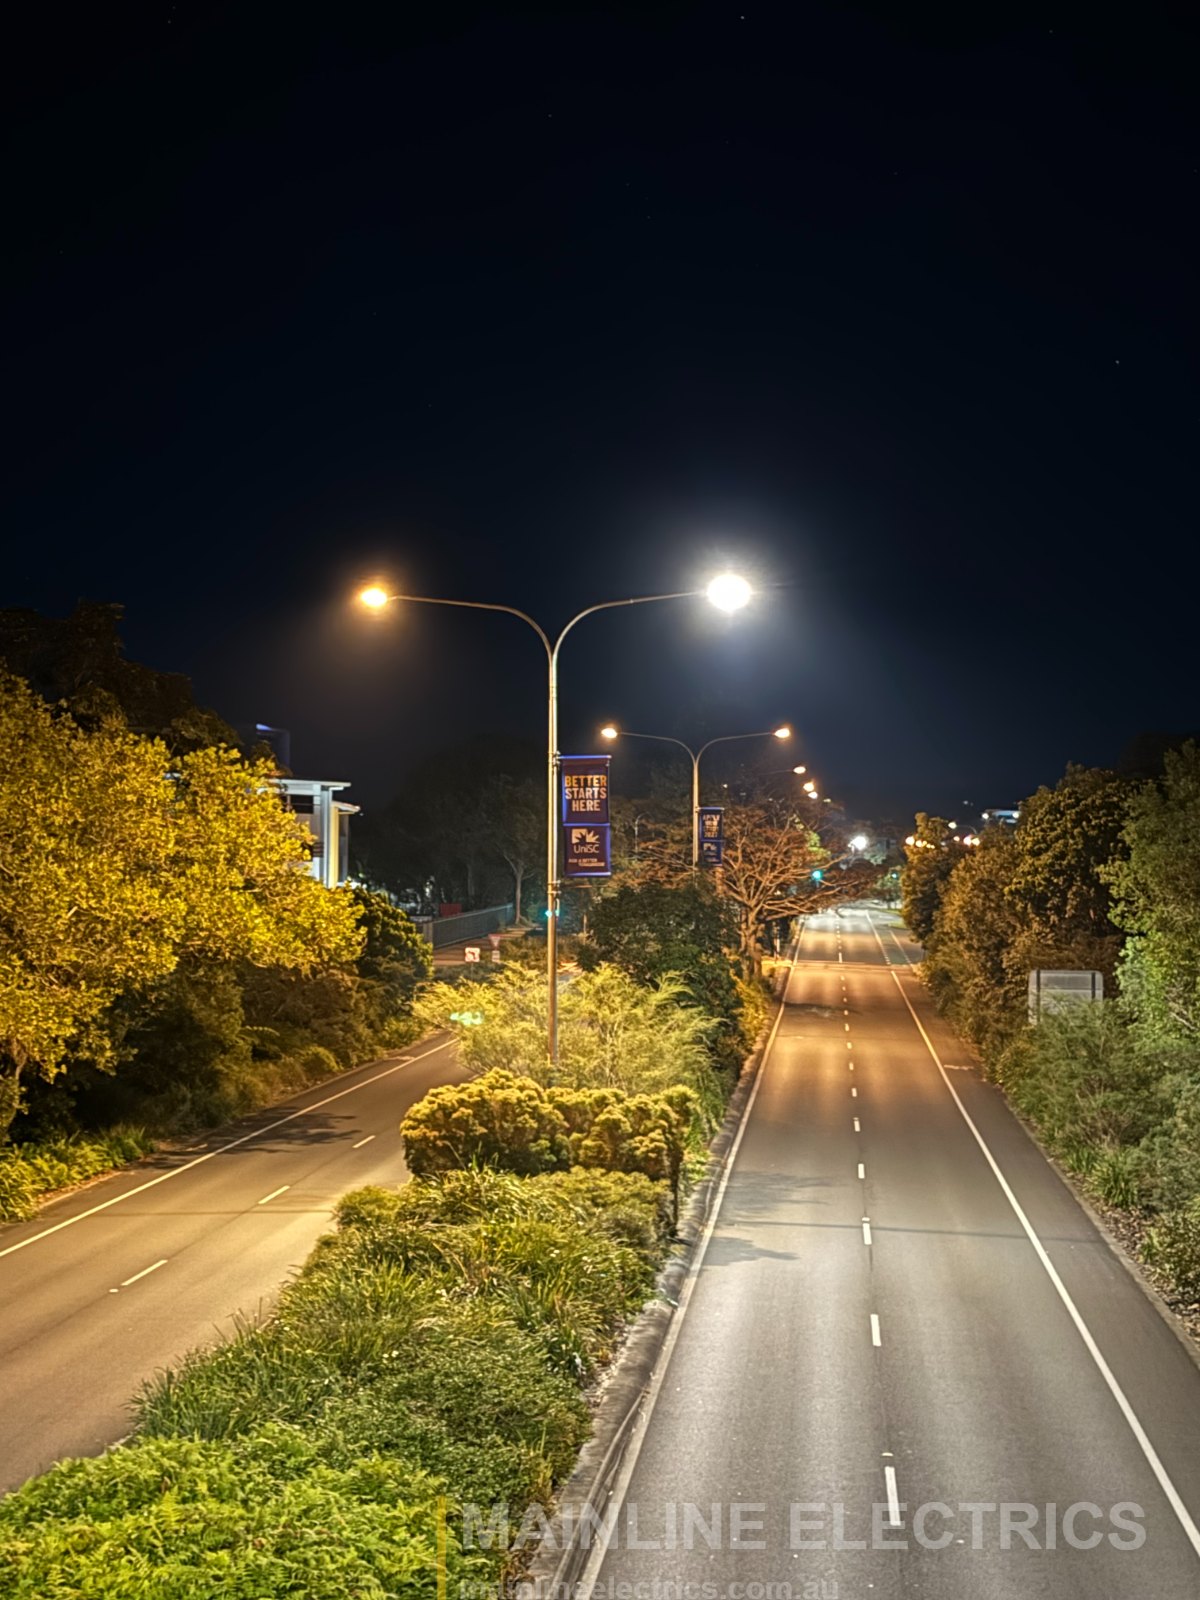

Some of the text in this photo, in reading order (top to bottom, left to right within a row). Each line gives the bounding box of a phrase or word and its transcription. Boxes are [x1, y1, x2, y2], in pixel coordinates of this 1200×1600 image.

[564, 775, 607, 787] BETTER
[565, 787, 607, 799] STARTS
[572, 799, 601, 811] HERE
[573, 844, 600, 854] UniSC
